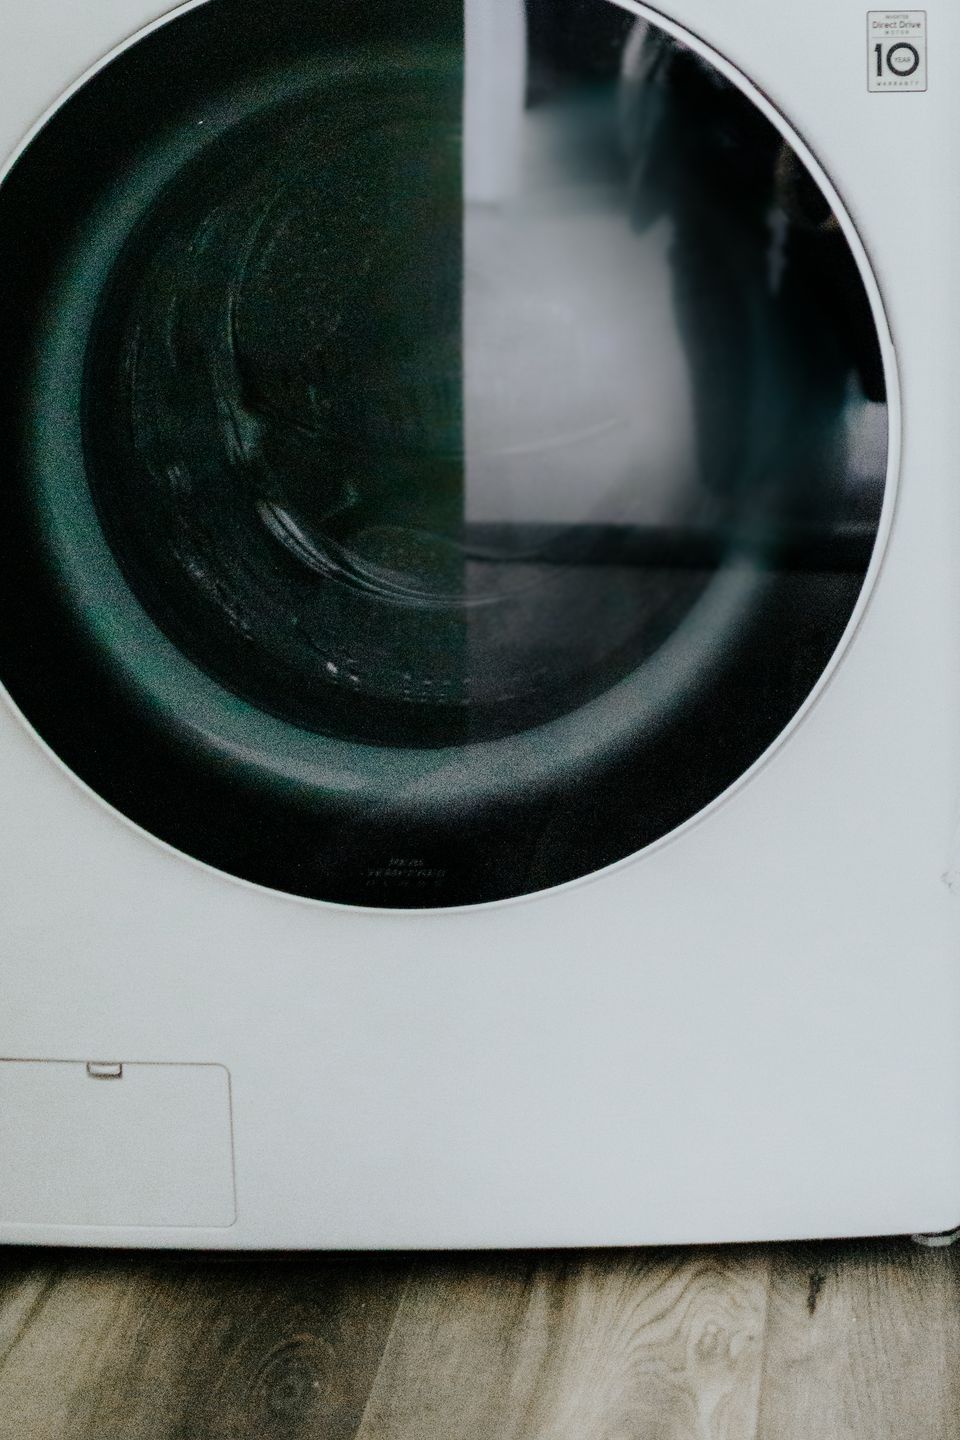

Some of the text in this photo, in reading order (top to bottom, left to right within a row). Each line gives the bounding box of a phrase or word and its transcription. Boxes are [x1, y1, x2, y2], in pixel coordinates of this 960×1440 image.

[872, 20, 921, 29] Direct Drive
[874, 42, 920, 77] 10
